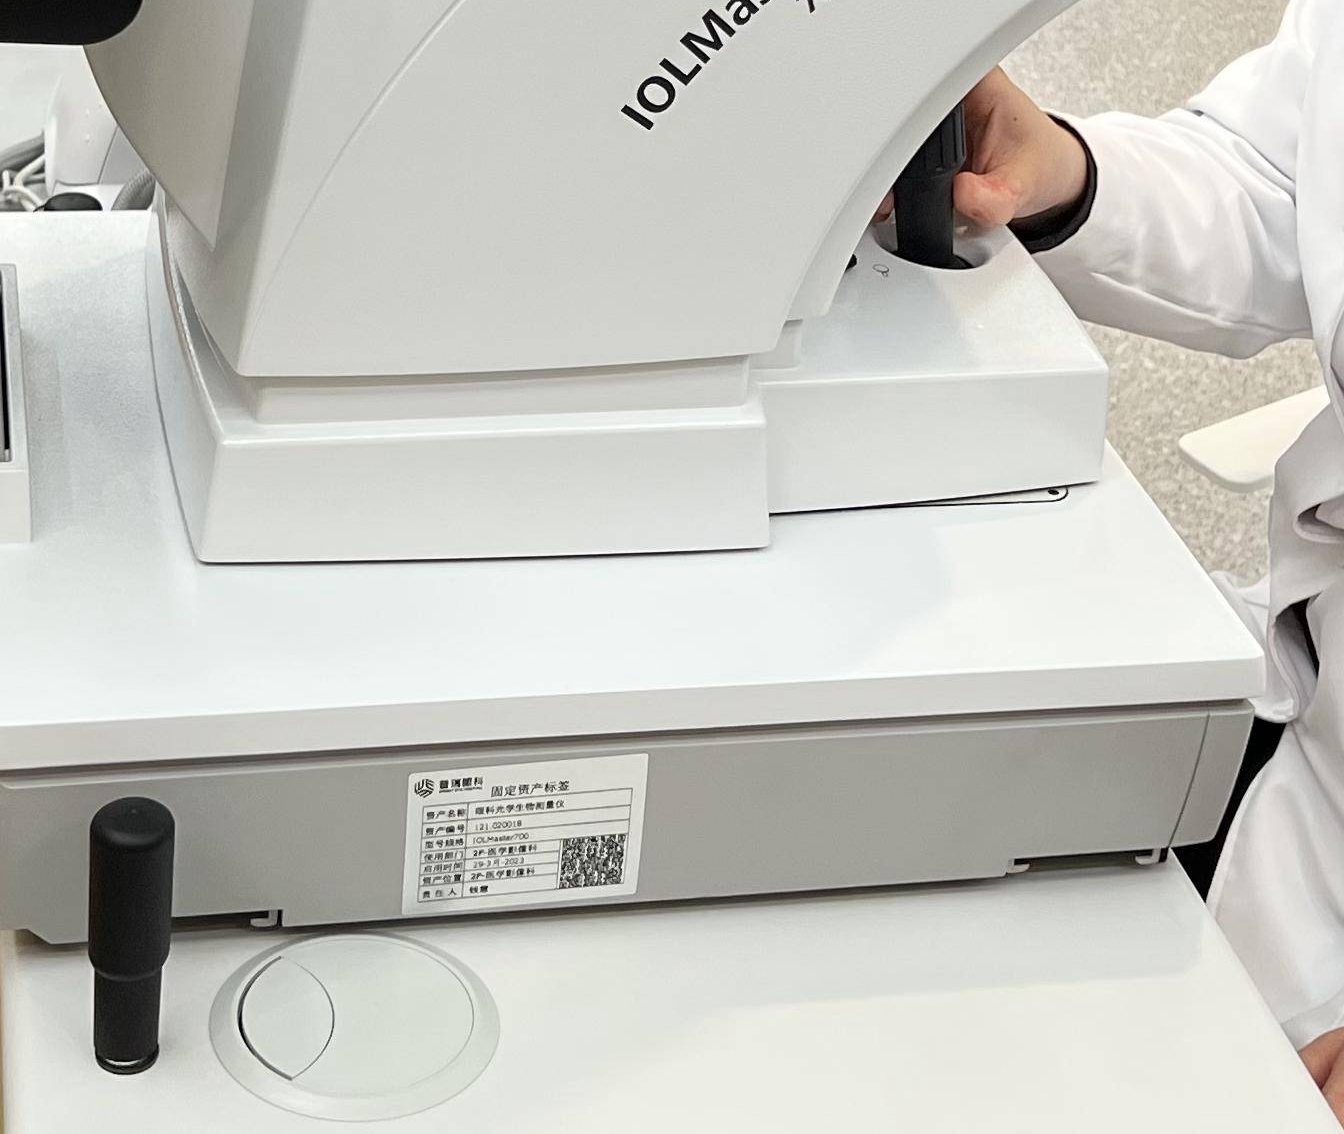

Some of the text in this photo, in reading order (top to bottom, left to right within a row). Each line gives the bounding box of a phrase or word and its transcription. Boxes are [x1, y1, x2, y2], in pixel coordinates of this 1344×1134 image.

[490, 780, 570, 798] 固定资产标签
